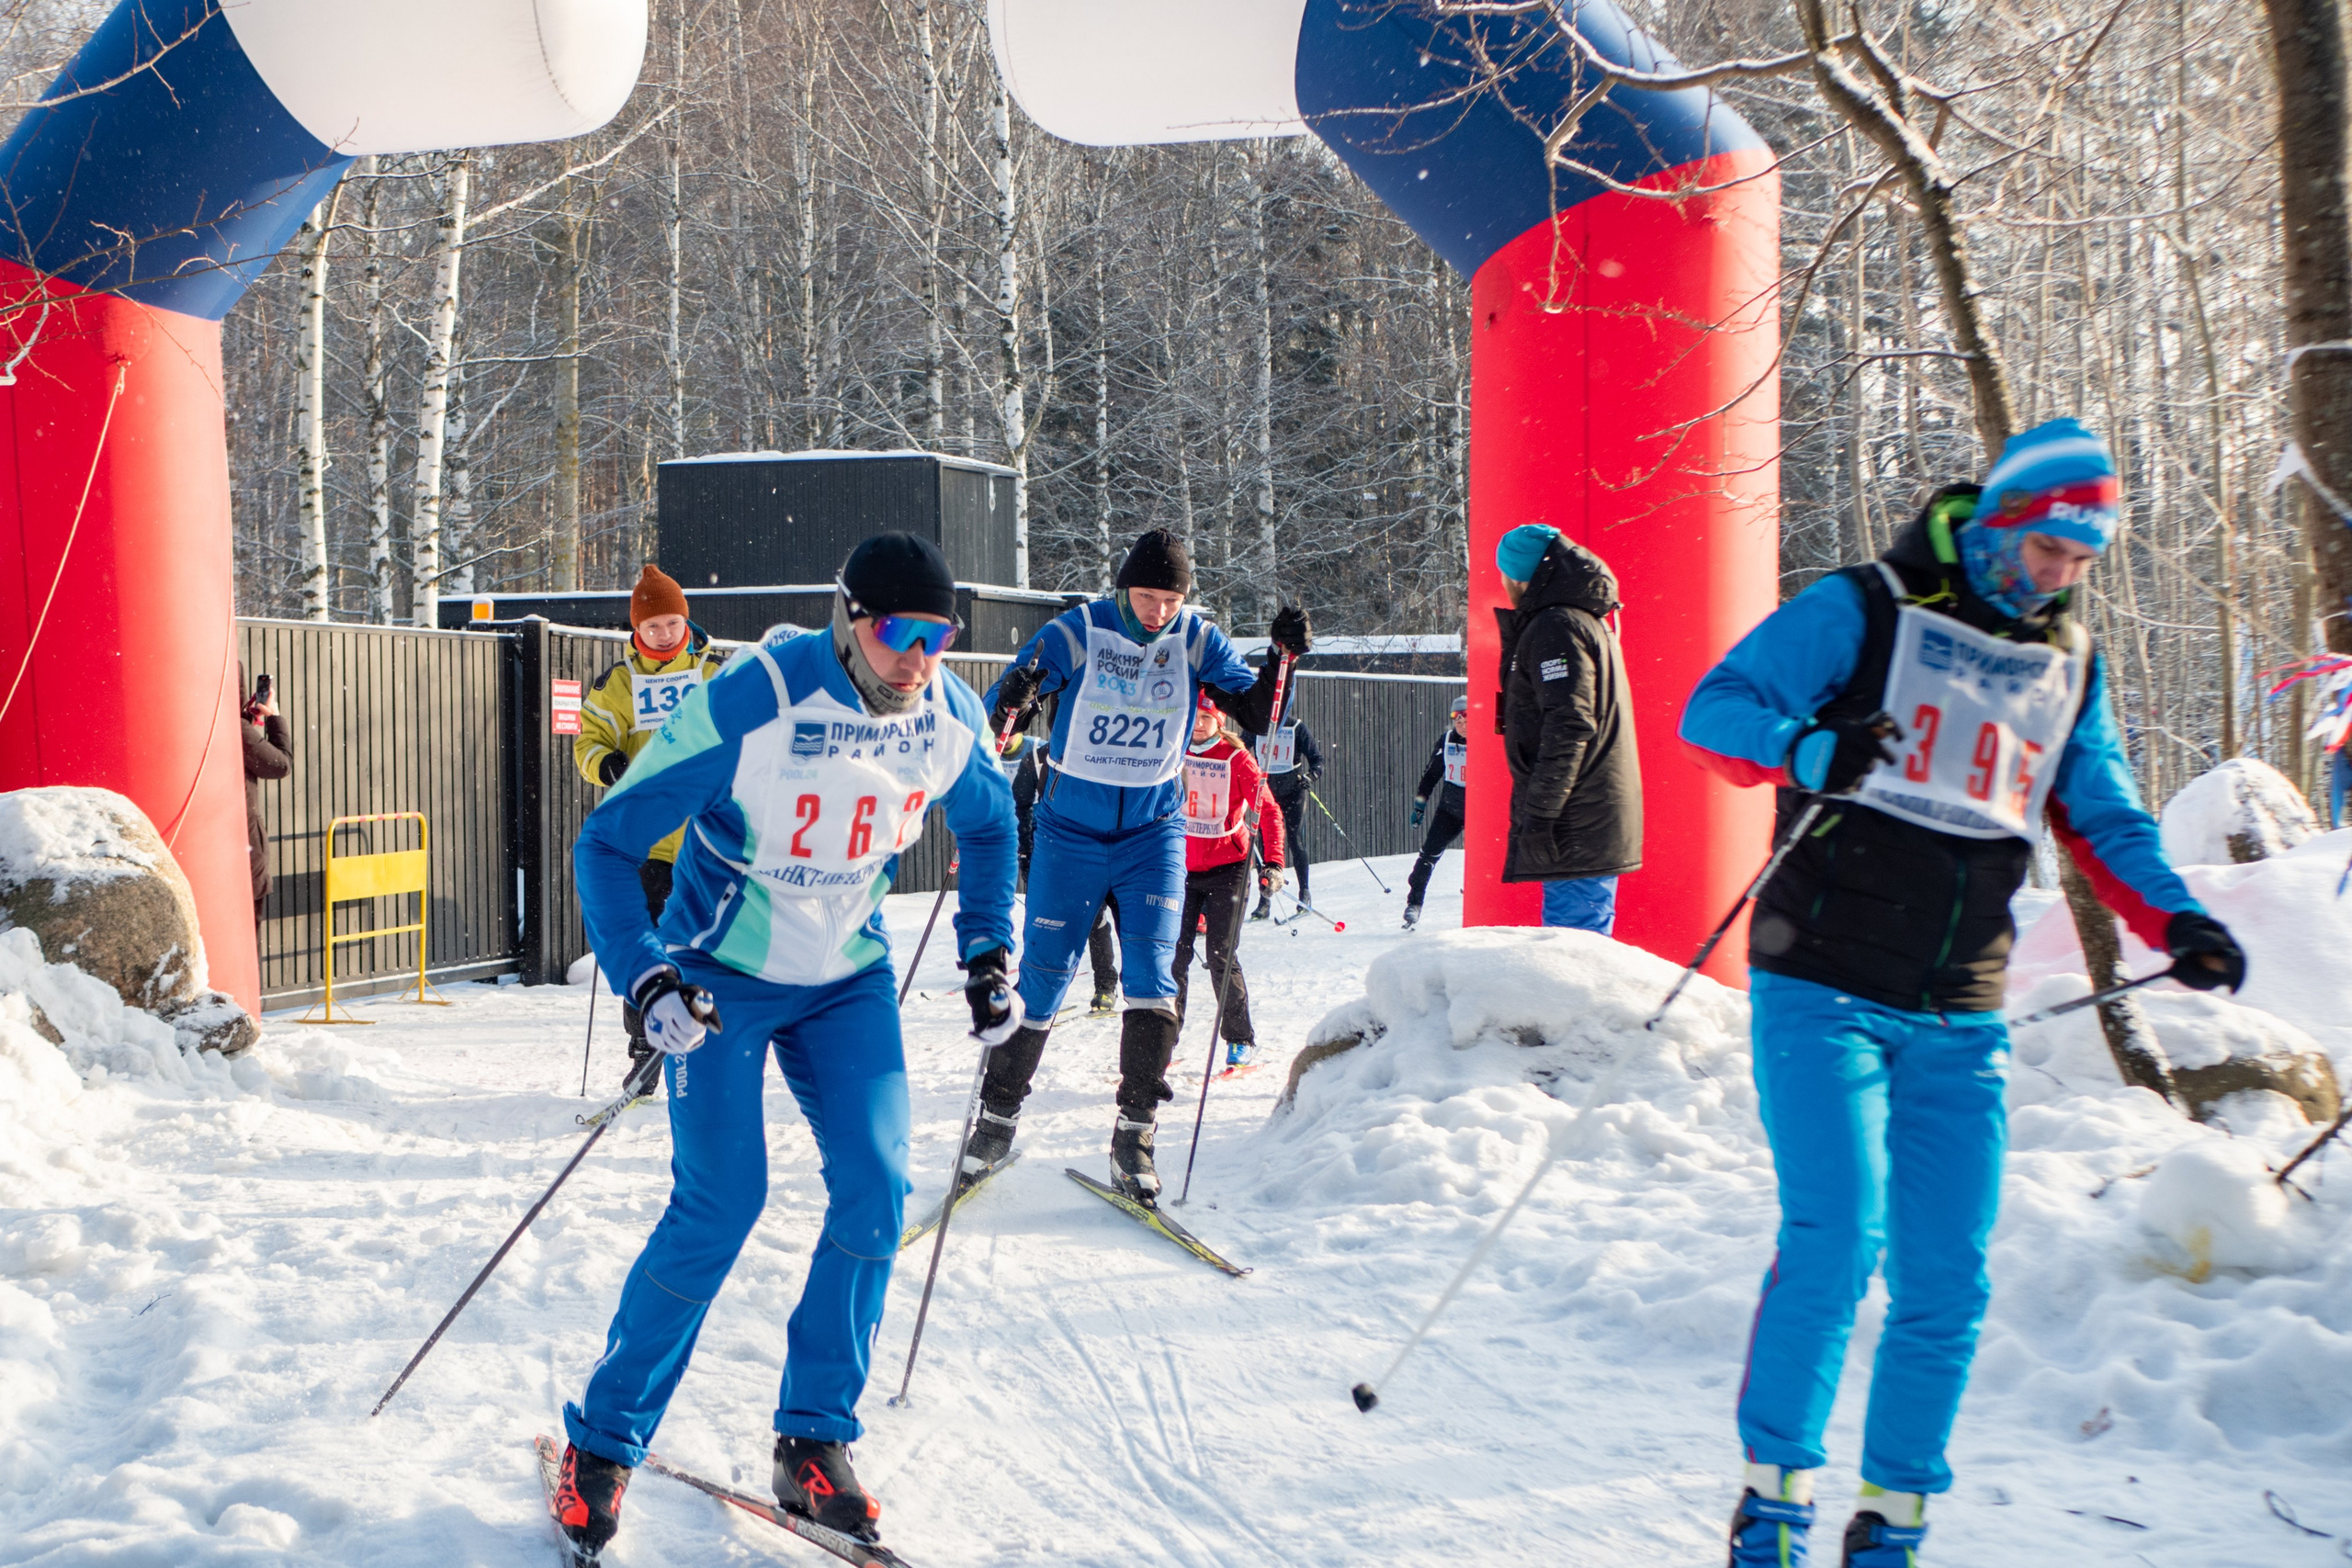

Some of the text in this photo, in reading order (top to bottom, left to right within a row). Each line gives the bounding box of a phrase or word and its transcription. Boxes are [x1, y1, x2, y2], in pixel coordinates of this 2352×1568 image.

[1097, 673, 1136, 696] 2023
[831, 709, 935, 743] ПРИМОРСКИЙ
[1089, 714, 1166, 749] 8221
[828, 738, 935, 760] РАЙОН
[1084, 754, 1164, 768] САНКТ-ПЕТЕРБУРГ
[1185, 759, 1227, 772] ПРИМОРСКИЙ
[1191, 770, 1227, 779] АЙОН
[1112, 1195, 1149, 1223] FISCHER
[796, 1517, 854, 1561] ROSSIGNOL
